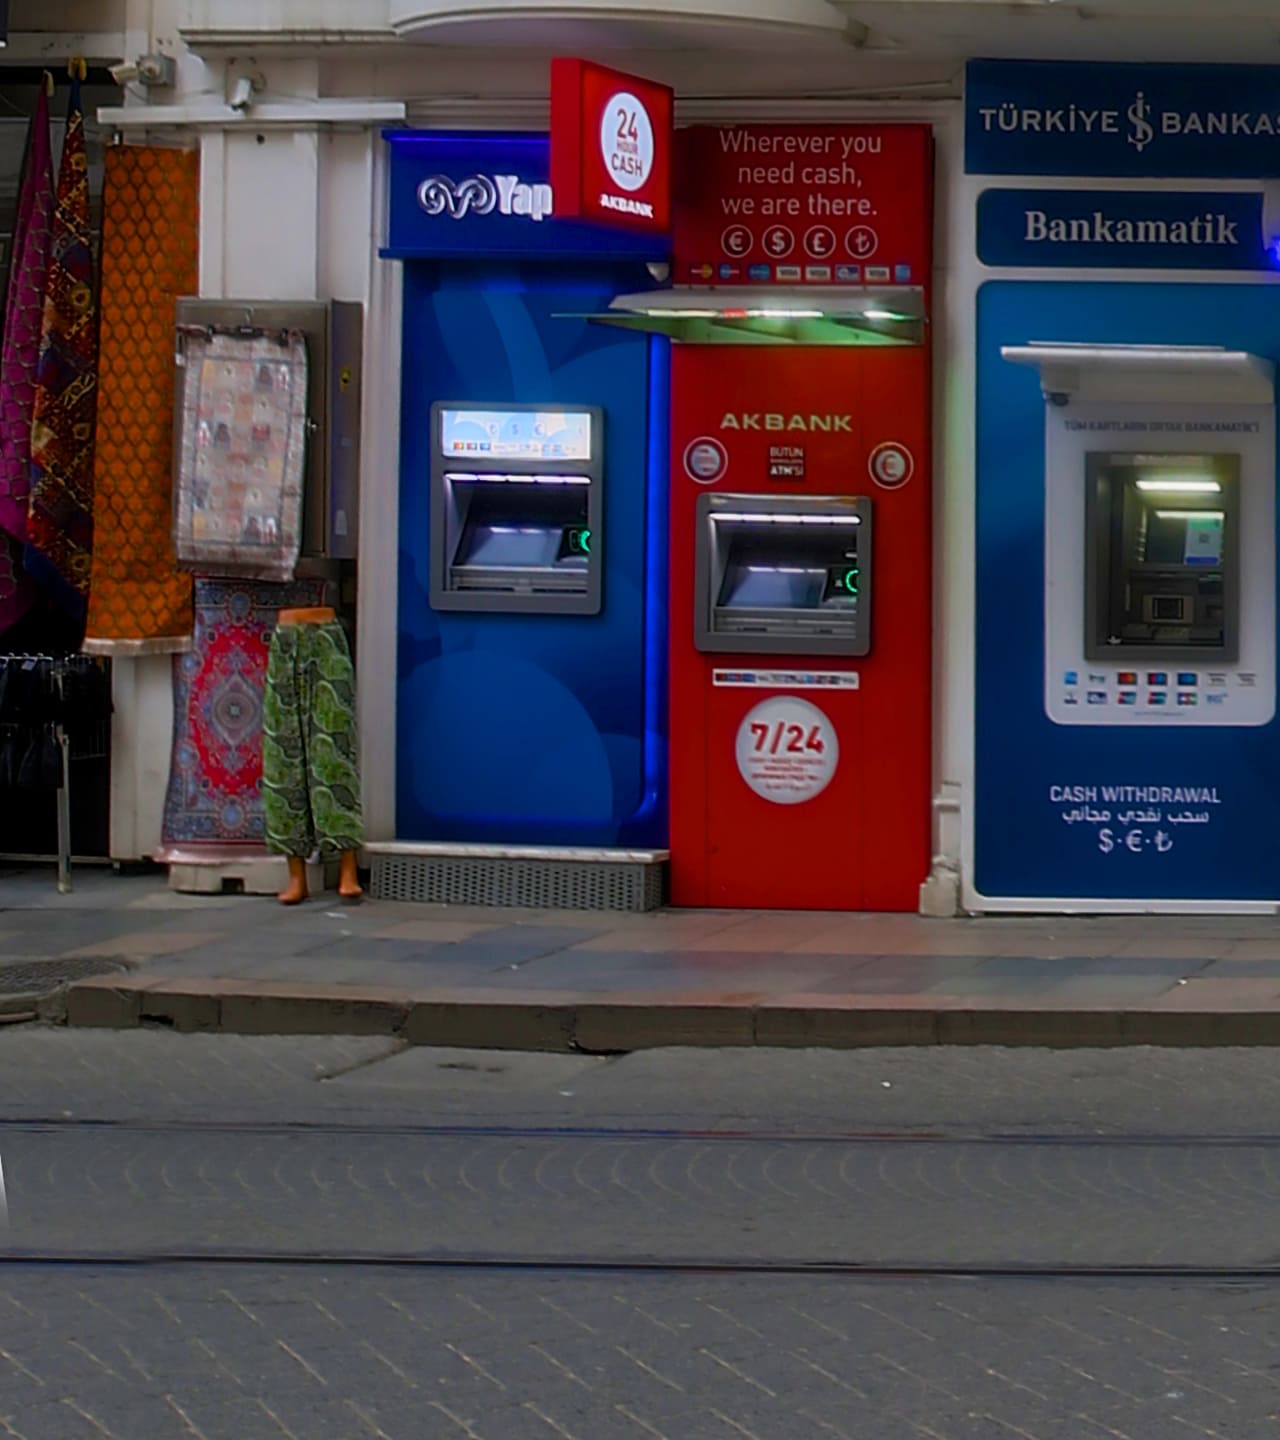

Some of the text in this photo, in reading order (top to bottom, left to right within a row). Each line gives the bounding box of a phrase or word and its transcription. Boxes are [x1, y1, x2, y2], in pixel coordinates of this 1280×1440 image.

[616, 108, 638, 141] 24
[979, 104, 1119, 132] TÜRKİYE
[719, 130, 881, 158] Wherever you
[611, 153, 644, 177] CASH
[738, 164, 863, 188] need cash,
[600, 194, 654, 218] AKBANK
[721, 194, 877, 216] we are there.
[1025, 211, 1238, 244] Bankamatik
[720, 413, 853, 432] AKBANK
[750, 720, 824, 754] 7/24
[1050, 786, 1221, 804] CASH WITHDRAWAL
